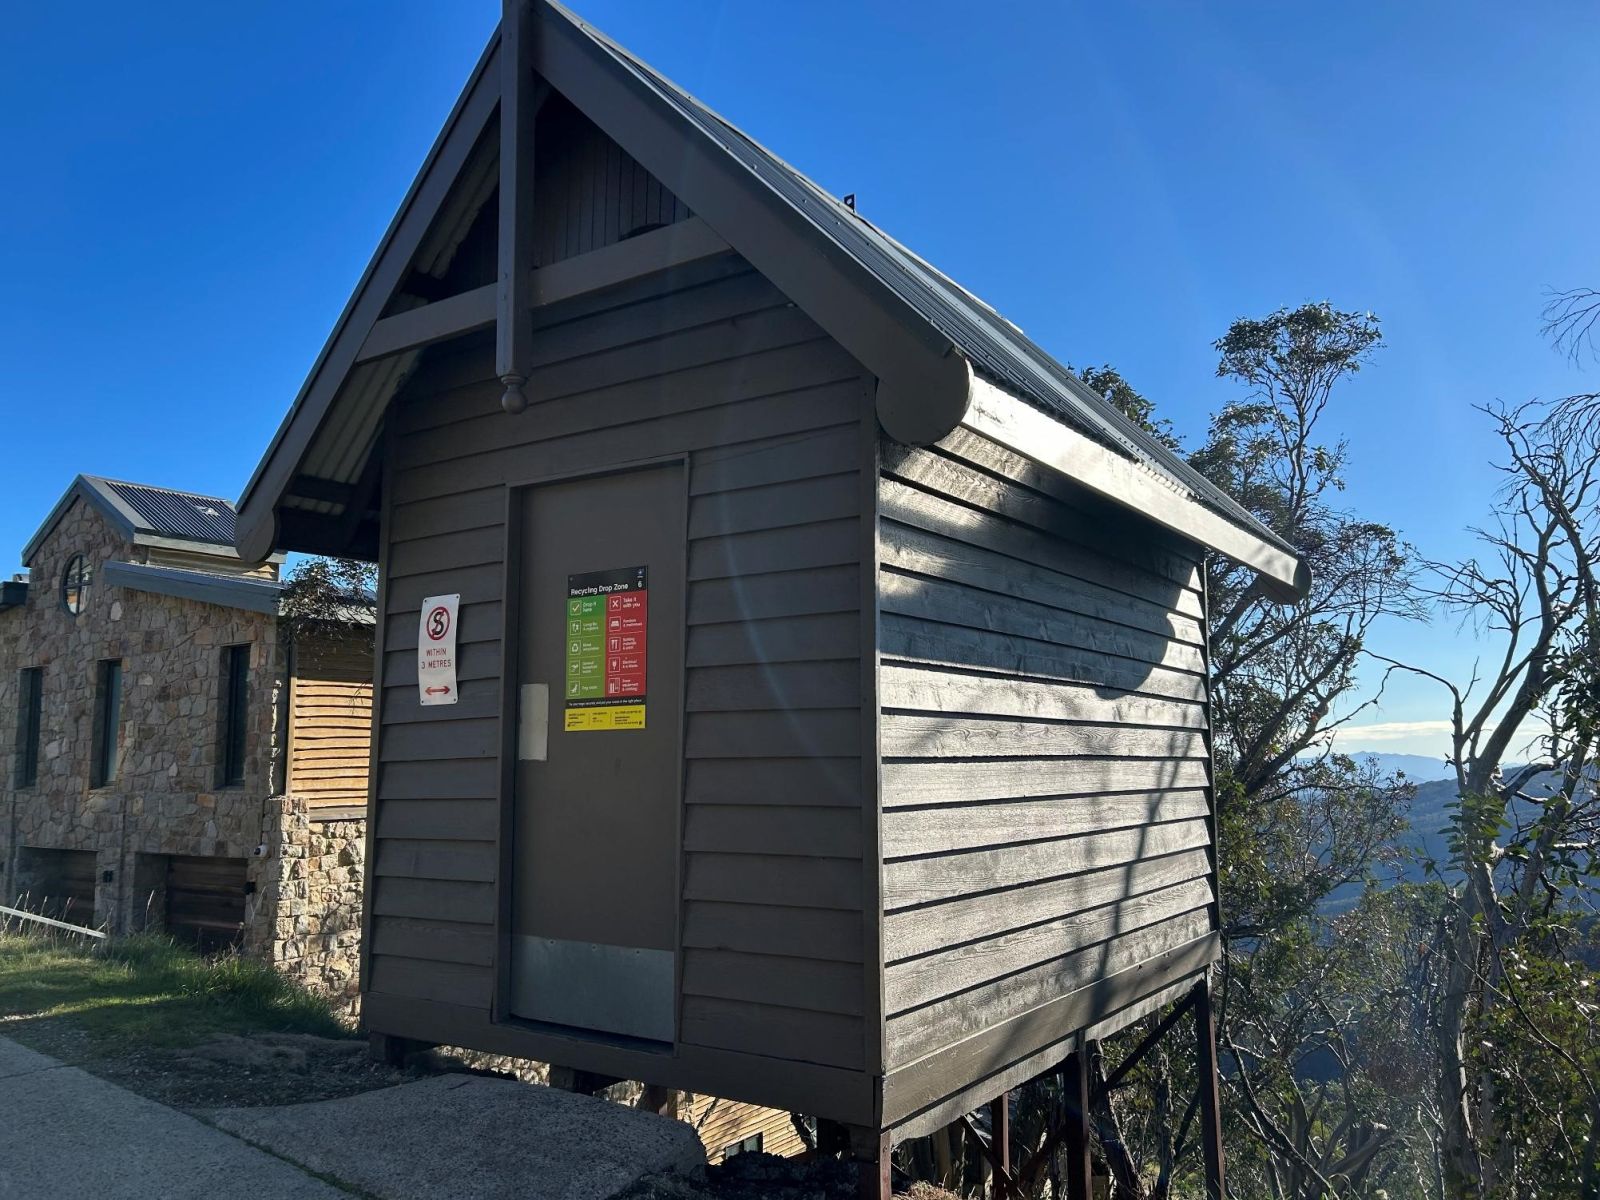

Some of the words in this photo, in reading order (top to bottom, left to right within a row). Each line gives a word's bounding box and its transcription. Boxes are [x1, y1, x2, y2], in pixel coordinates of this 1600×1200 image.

[637, 580, 643, 588] 6
[570, 586, 597, 596] Recycling
[426, 648, 447, 657] WITHIN
[421, 661, 426, 669] 3
[428, 660, 452, 669] METRES
